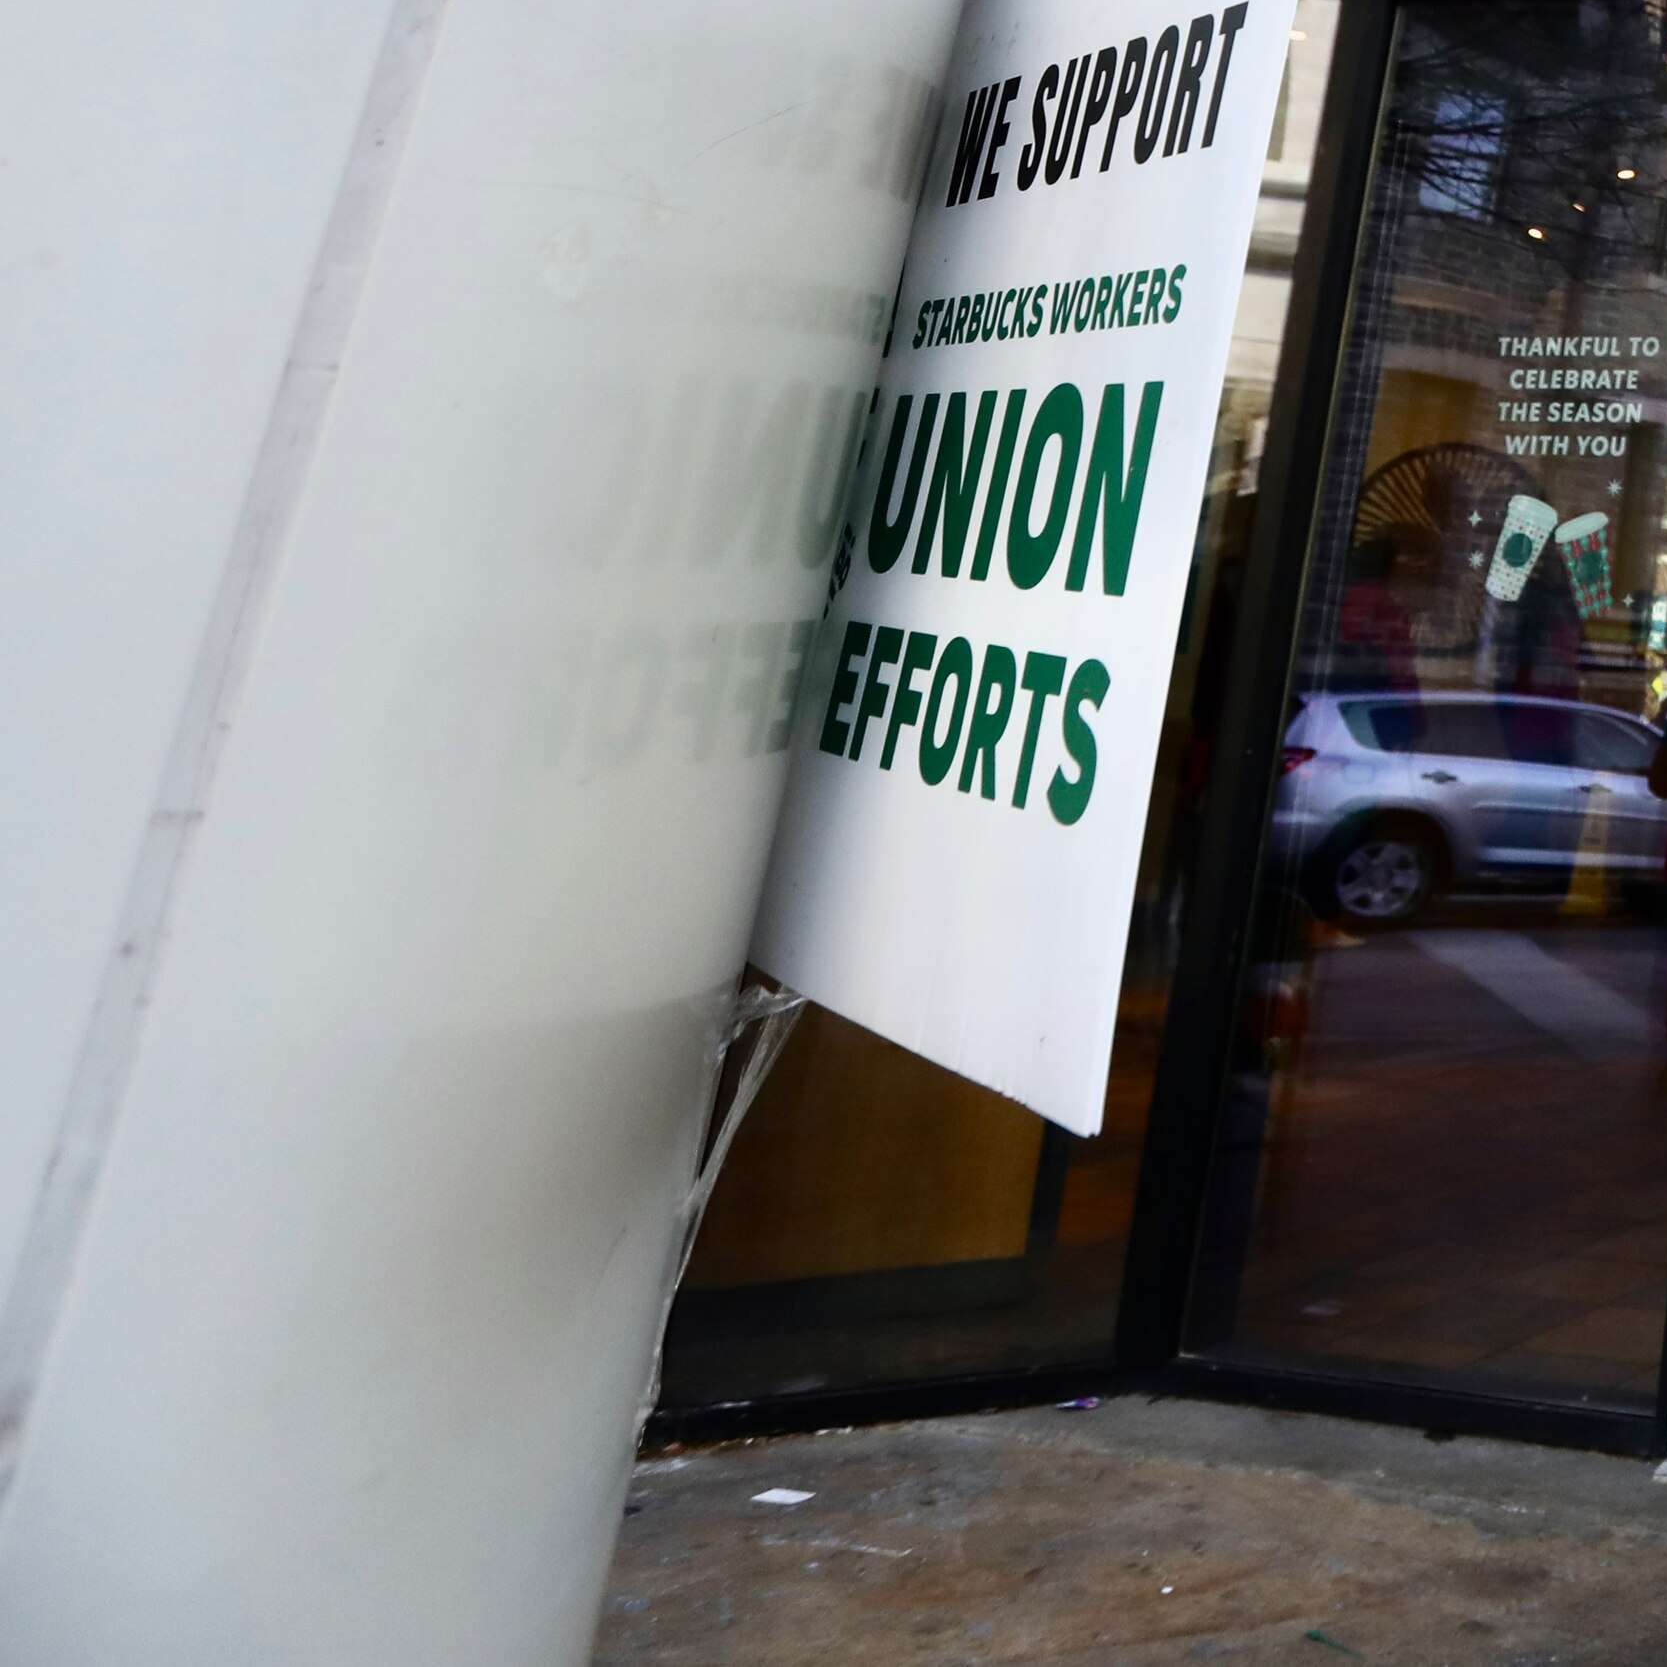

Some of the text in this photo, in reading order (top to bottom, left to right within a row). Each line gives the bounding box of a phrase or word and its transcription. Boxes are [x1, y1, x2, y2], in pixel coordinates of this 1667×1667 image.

[945, 1, 1249, 208] WE SUPPORT
[911, 264, 1187, 351] STARBUCKS WORKERS
[1498, 336, 1660, 357] THANKFUL TO
[1508, 369, 1640, 390] CELEBRATE
[1498, 401, 1643, 423] THE SEASON
[1504, 435, 1627, 457] WITH YOU
[867, 380, 1164, 597] UNION
[819, 621, 1111, 826] EFFORTS
